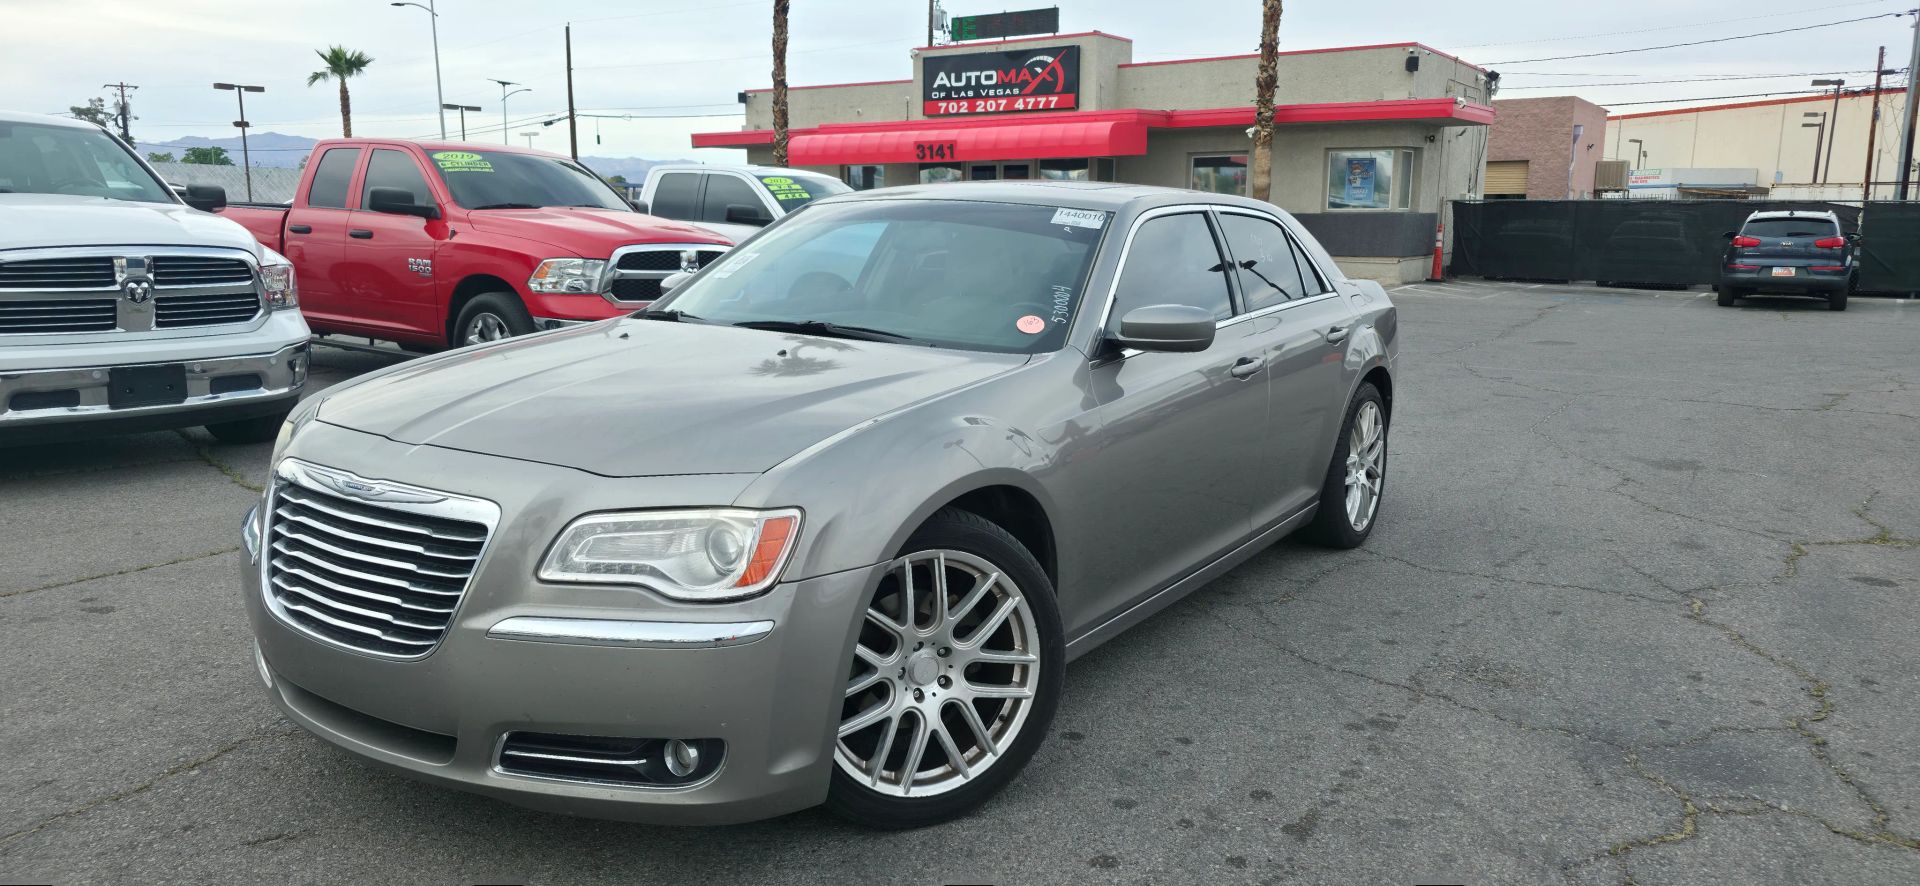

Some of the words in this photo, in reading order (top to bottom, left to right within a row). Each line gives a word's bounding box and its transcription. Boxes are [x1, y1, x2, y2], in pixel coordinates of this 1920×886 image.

[933, 51, 1066, 93] AUTOMAX
[932, 91, 946, 99] OF
[951, 90, 974, 98] LAS
[980, 88, 1020, 96] VEGAS
[938, 102, 969, 113] 702
[975, 100, 1007, 112] 207
[1014, 96, 1059, 110] 4777
[916, 144, 954, 160] 3141
[1059, 210, 1106, 222] 1440010
[408, 257, 431, 266] RAM
[408, 264, 432, 273] 1500
